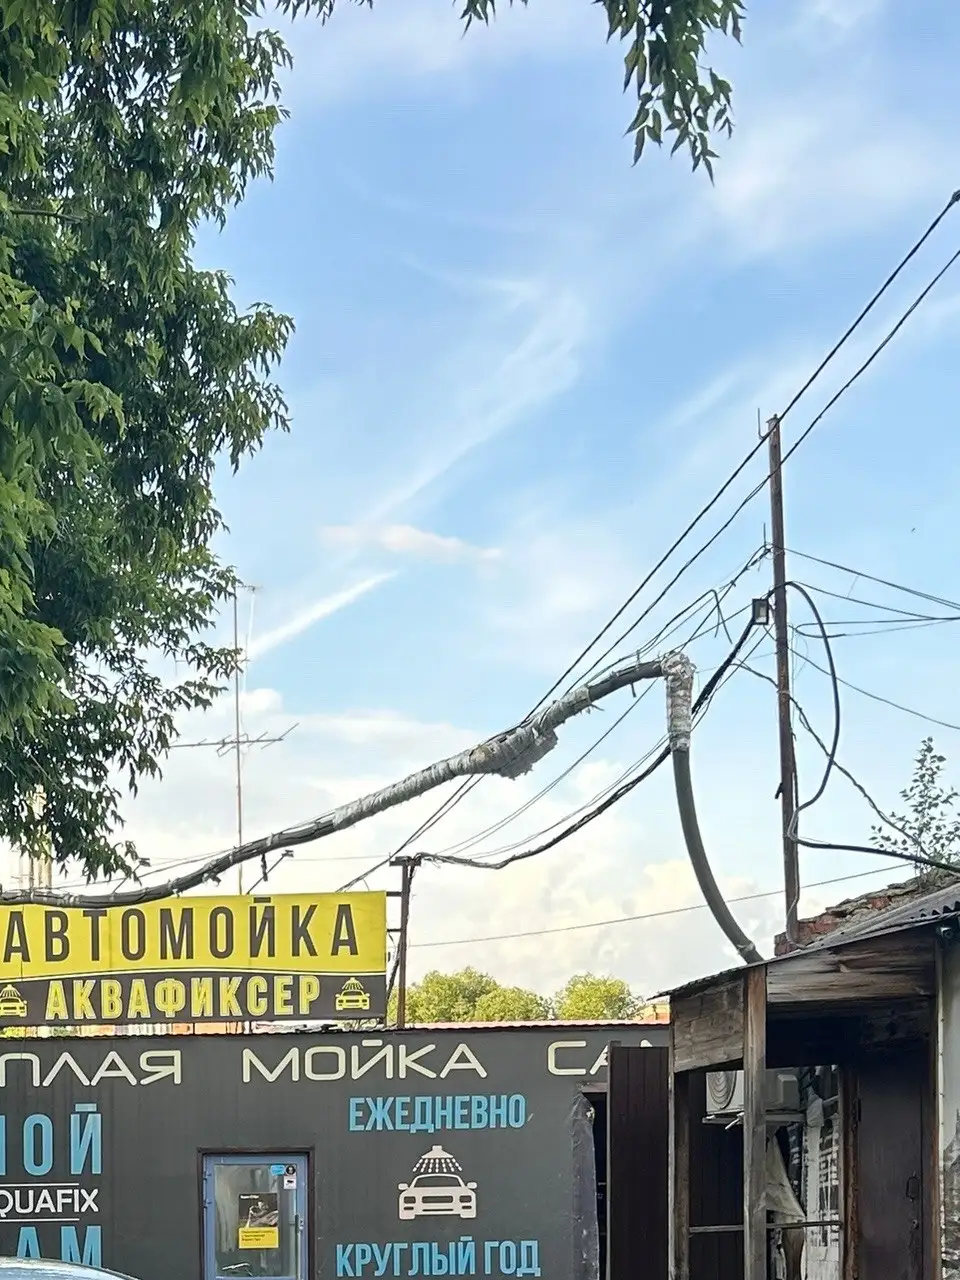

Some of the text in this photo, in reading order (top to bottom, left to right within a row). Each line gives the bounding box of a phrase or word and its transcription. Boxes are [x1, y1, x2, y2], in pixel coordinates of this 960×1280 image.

[3, 896, 359, 963] АВТОМОЙКА
[44, 975, 321, 1021] АКВАФИКСЕР
[242, 1038, 488, 1084] МОЙКА
[348, 1094, 526, 1133] ЕЖЕДНЕВНО
[336, 1235, 541, 1278] КРУГЛЫЙ ГОД
